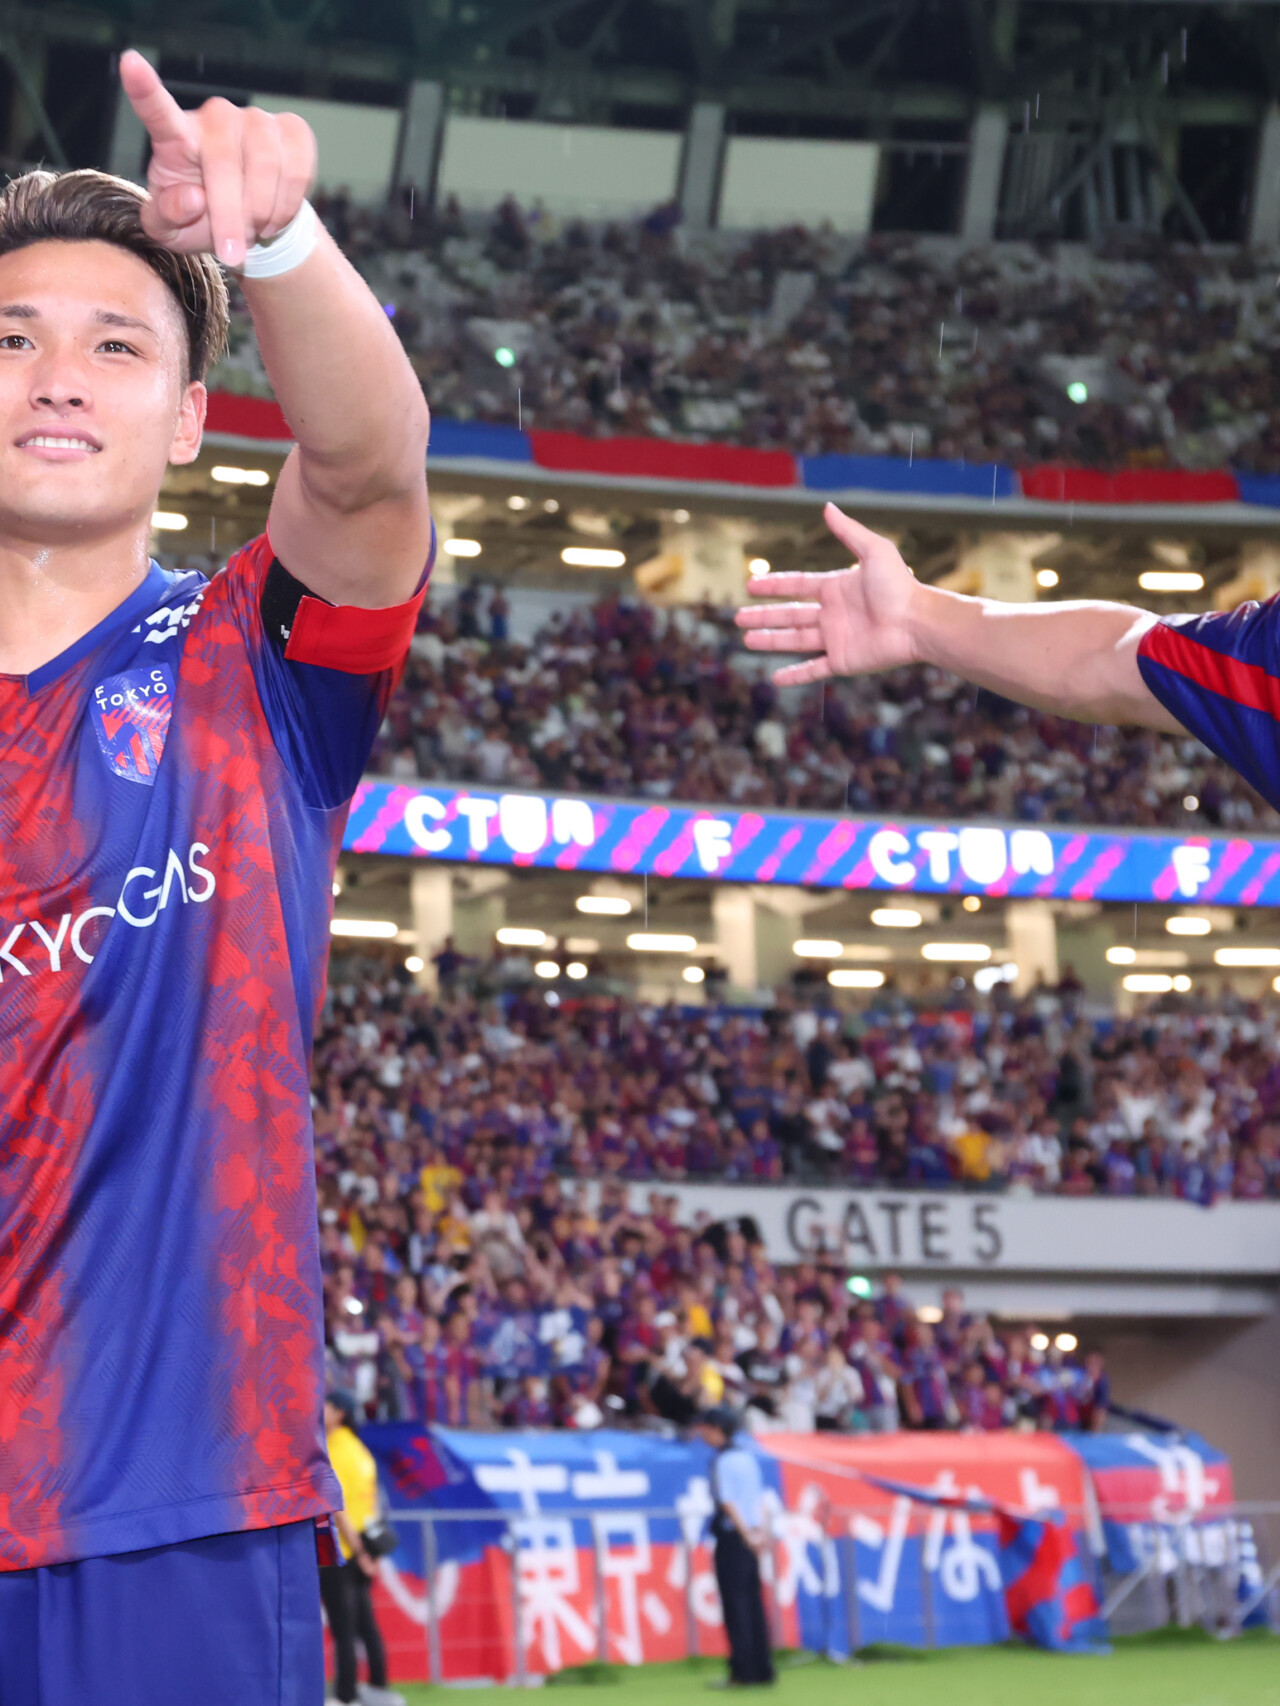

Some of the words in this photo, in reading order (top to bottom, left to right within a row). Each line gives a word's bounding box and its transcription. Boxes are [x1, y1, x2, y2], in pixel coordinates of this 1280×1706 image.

[96, 682, 168, 711] TOKYO
[786, 1198, 951, 1261] GATE
[973, 1204, 1003, 1262] 5
